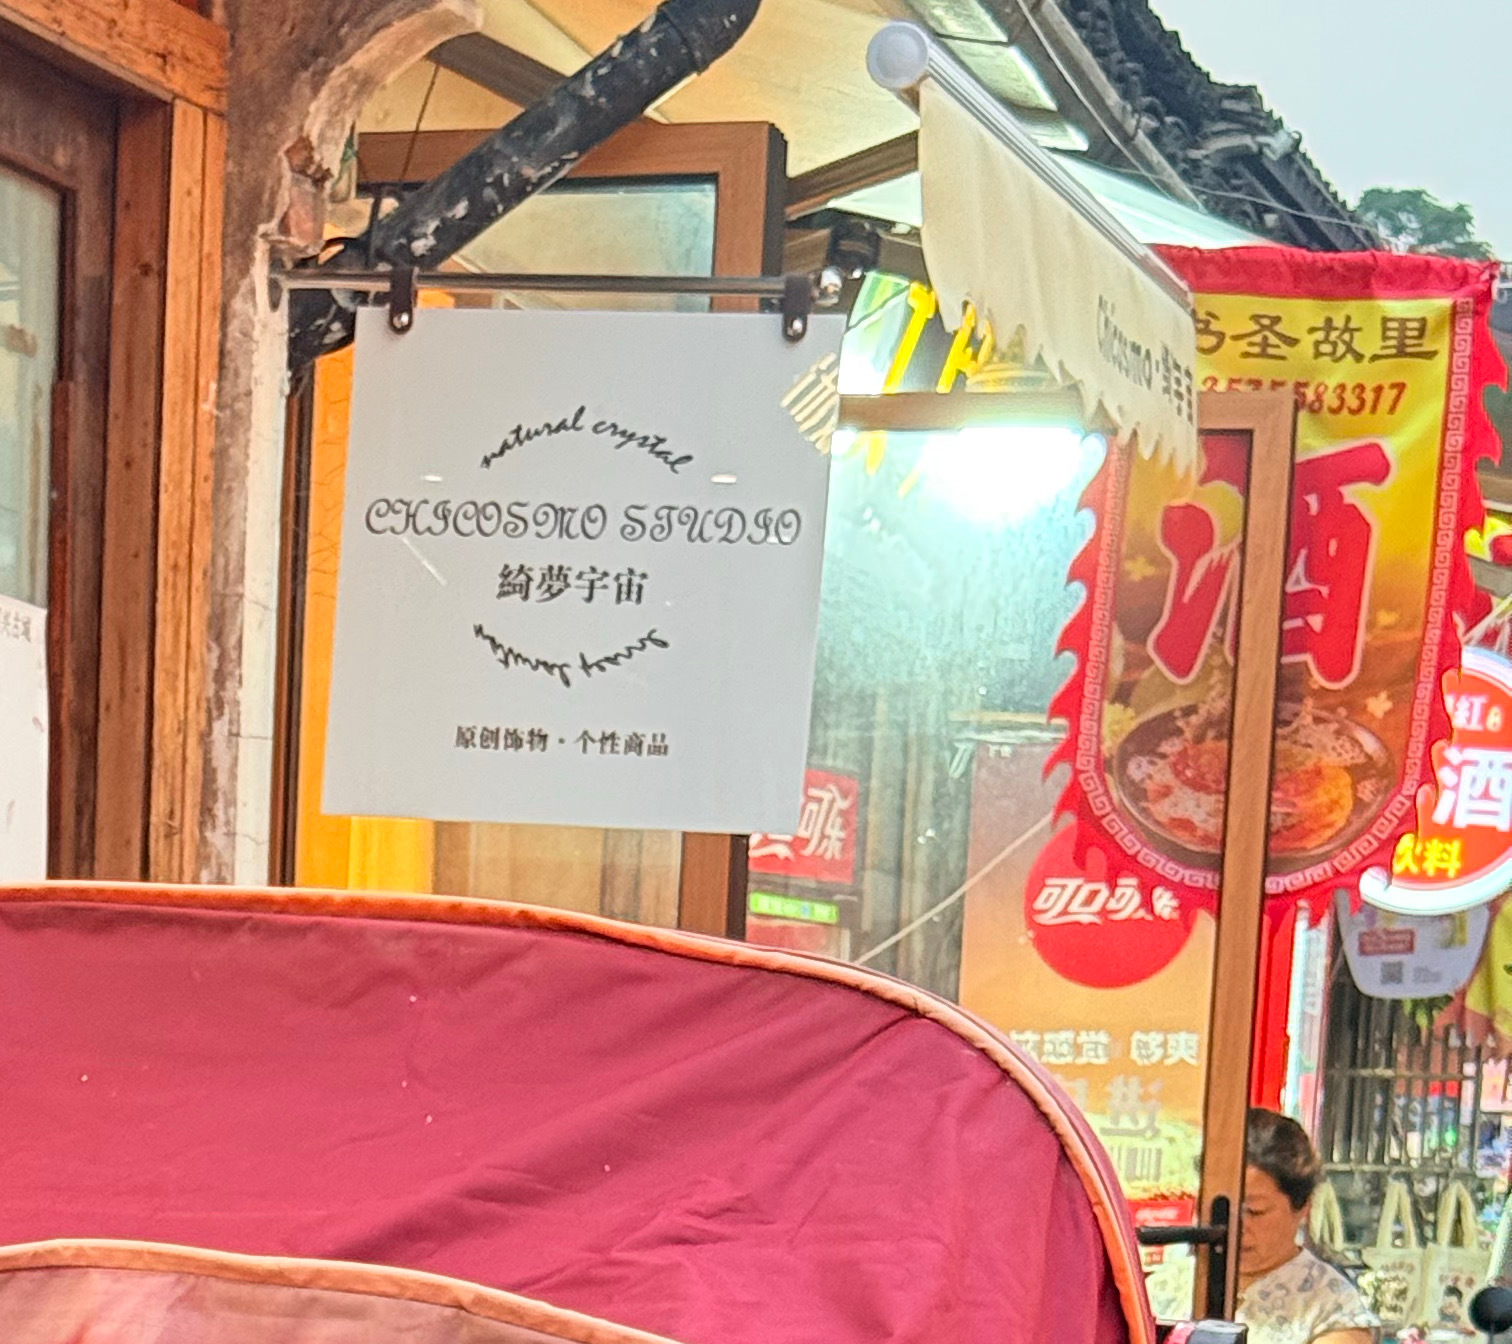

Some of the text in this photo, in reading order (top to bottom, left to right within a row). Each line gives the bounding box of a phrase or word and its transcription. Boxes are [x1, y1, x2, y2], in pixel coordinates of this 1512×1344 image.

[481, 406, 694, 475] natural crystal
[619, 502, 803, 546] STUDIO
[496, 563, 649, 606] 綺夢宇宙
[1431, 744, 1512, 832] 酒
